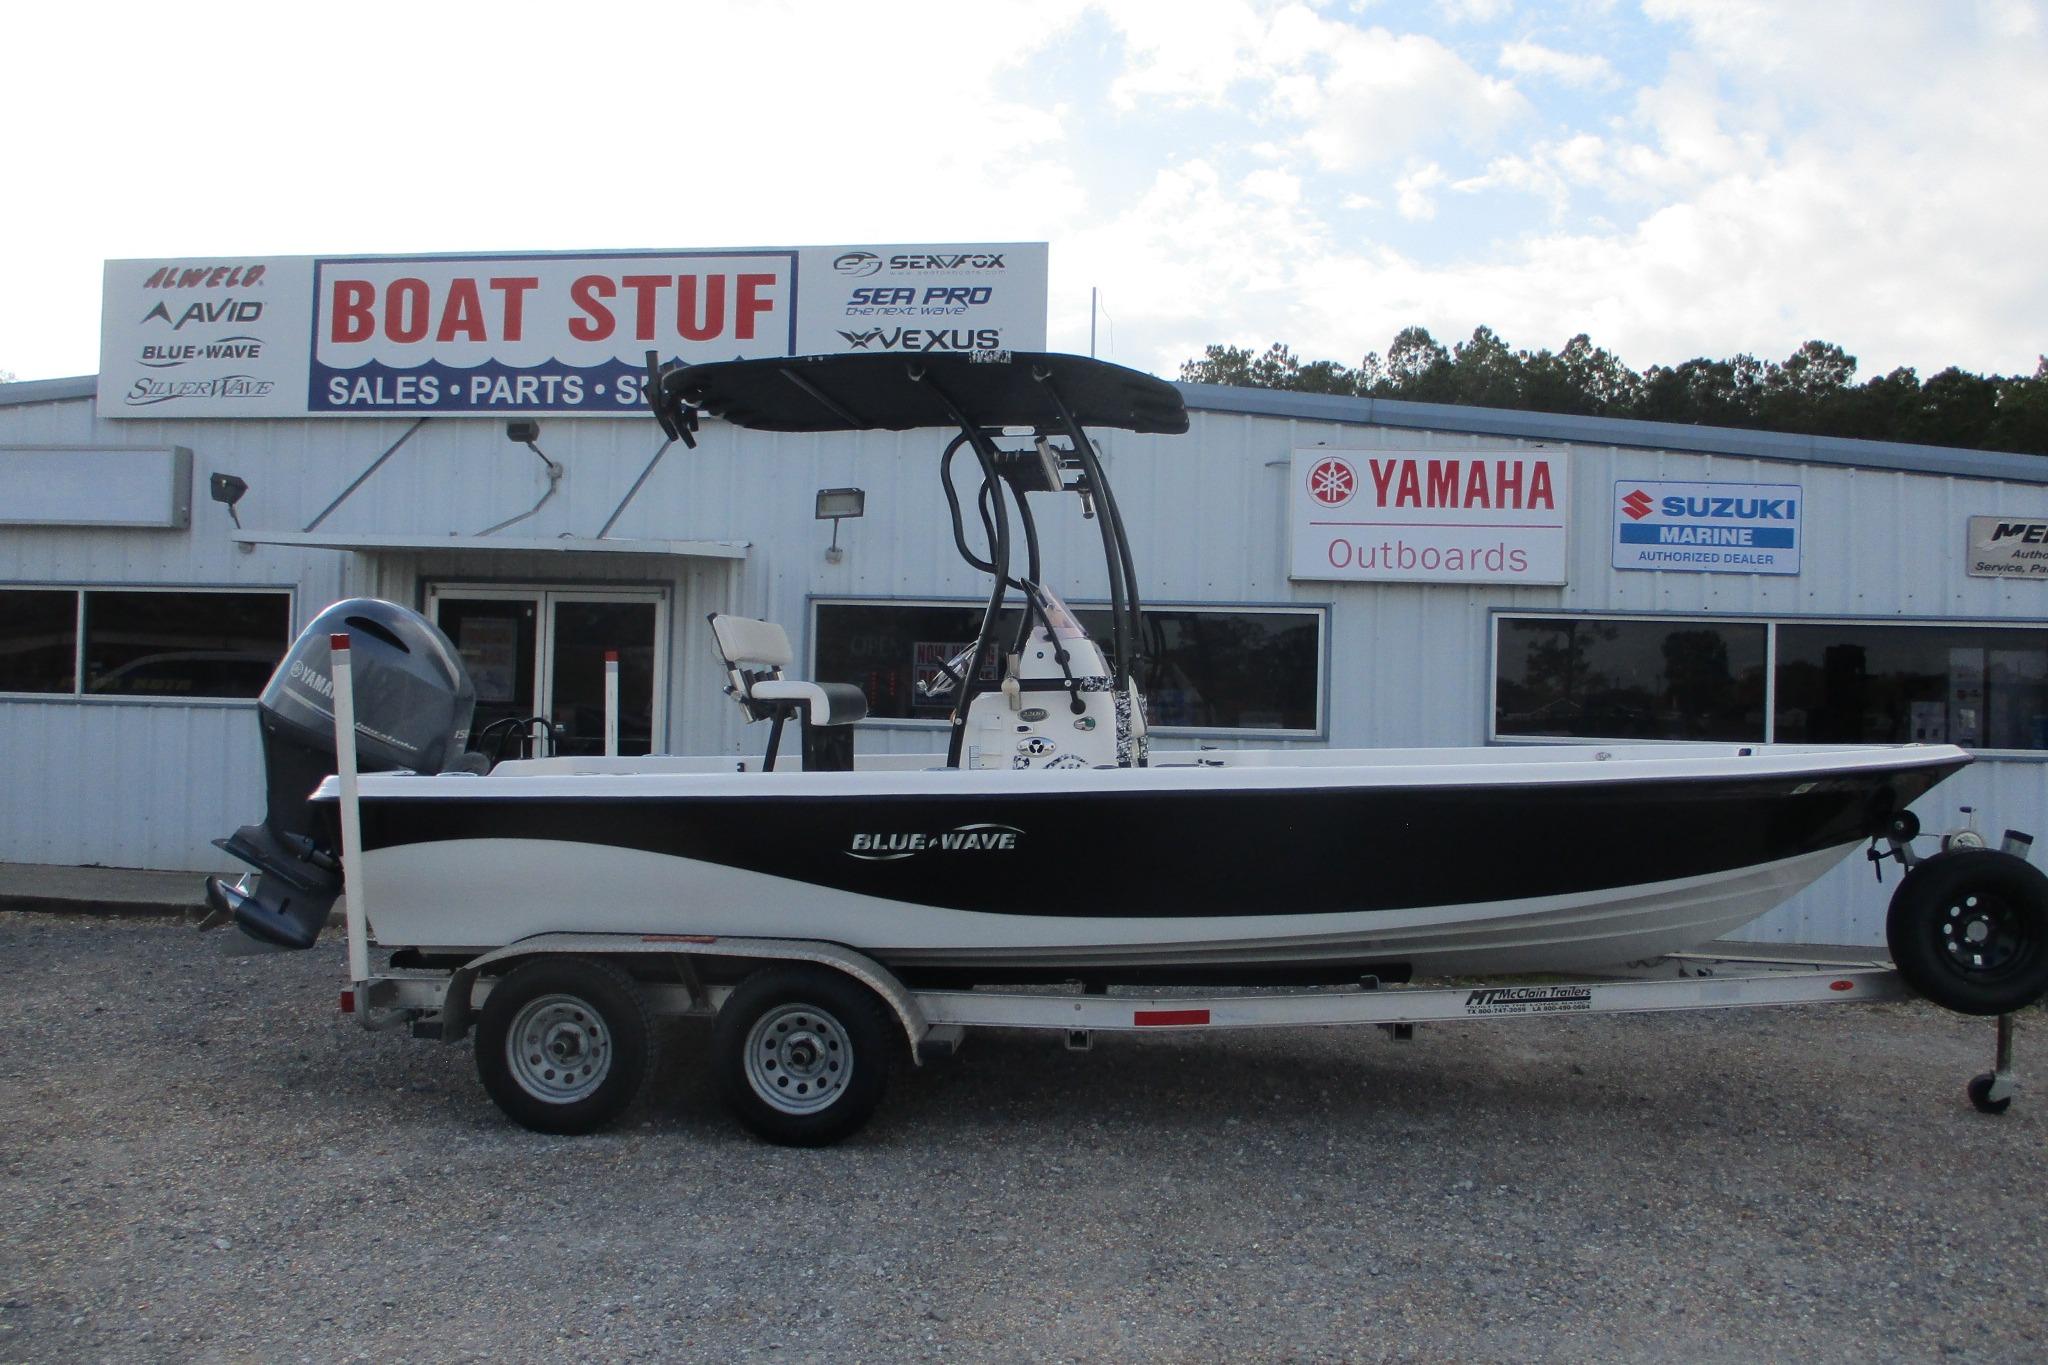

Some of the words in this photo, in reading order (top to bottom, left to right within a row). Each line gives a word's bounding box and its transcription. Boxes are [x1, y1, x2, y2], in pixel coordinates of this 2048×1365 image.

[143, 264, 267, 289] ALWELD
[331, 276, 539, 344] BOAT
[568, 273, 776, 342] STUF
[847, 287, 915, 306] SEA
[923, 287, 993, 308] PRO
[173, 298, 264, 331] AVID
[846, 307, 874, 316] the
[875, 307, 915, 316] next
[920, 307, 967, 316] wave
[875, 327, 1000, 351] VEXUS
[141, 345, 195, 360] BLUE
[206, 344, 262, 359] WAVE
[328, 375, 440, 405] SALES
[470, 375, 585, 405] PARTS
[1369, 459, 1555, 510] YAMAHA
[1661, 496, 1795, 520] SUZUKI
[1659, 527, 1753, 546] MARINE
[1328, 538, 1528, 572] Outboards
[1639, 551, 1720, 563] AUTHORIZED
[1724, 553, 1774, 565] DEALER
[1975, 561, 2025, 574] Service,
[301, 666, 334, 699] YAMA
[852, 833, 926, 850] BLUE
[941, 833, 1017, 850] WAVE
[1499, 988, 1547, 1000] McClain
[1550, 986, 1592, 998] Trailers
